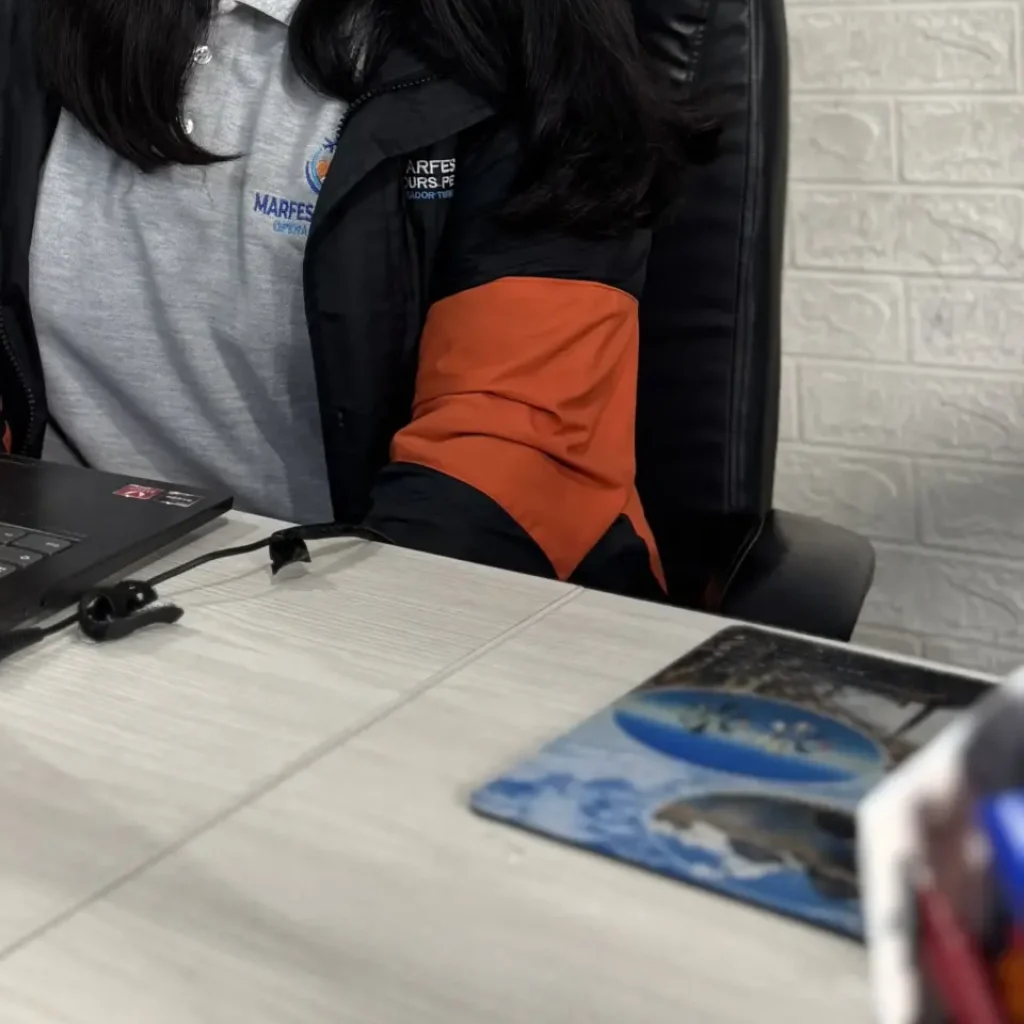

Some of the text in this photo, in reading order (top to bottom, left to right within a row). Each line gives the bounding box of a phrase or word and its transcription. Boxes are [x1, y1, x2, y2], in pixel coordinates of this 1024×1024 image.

[406, 158, 456, 174] ARFES
[406, 174, 455, 189] URS PE
[253, 192, 314, 222] MARFES
[273, 220, 308, 237] OPERA
